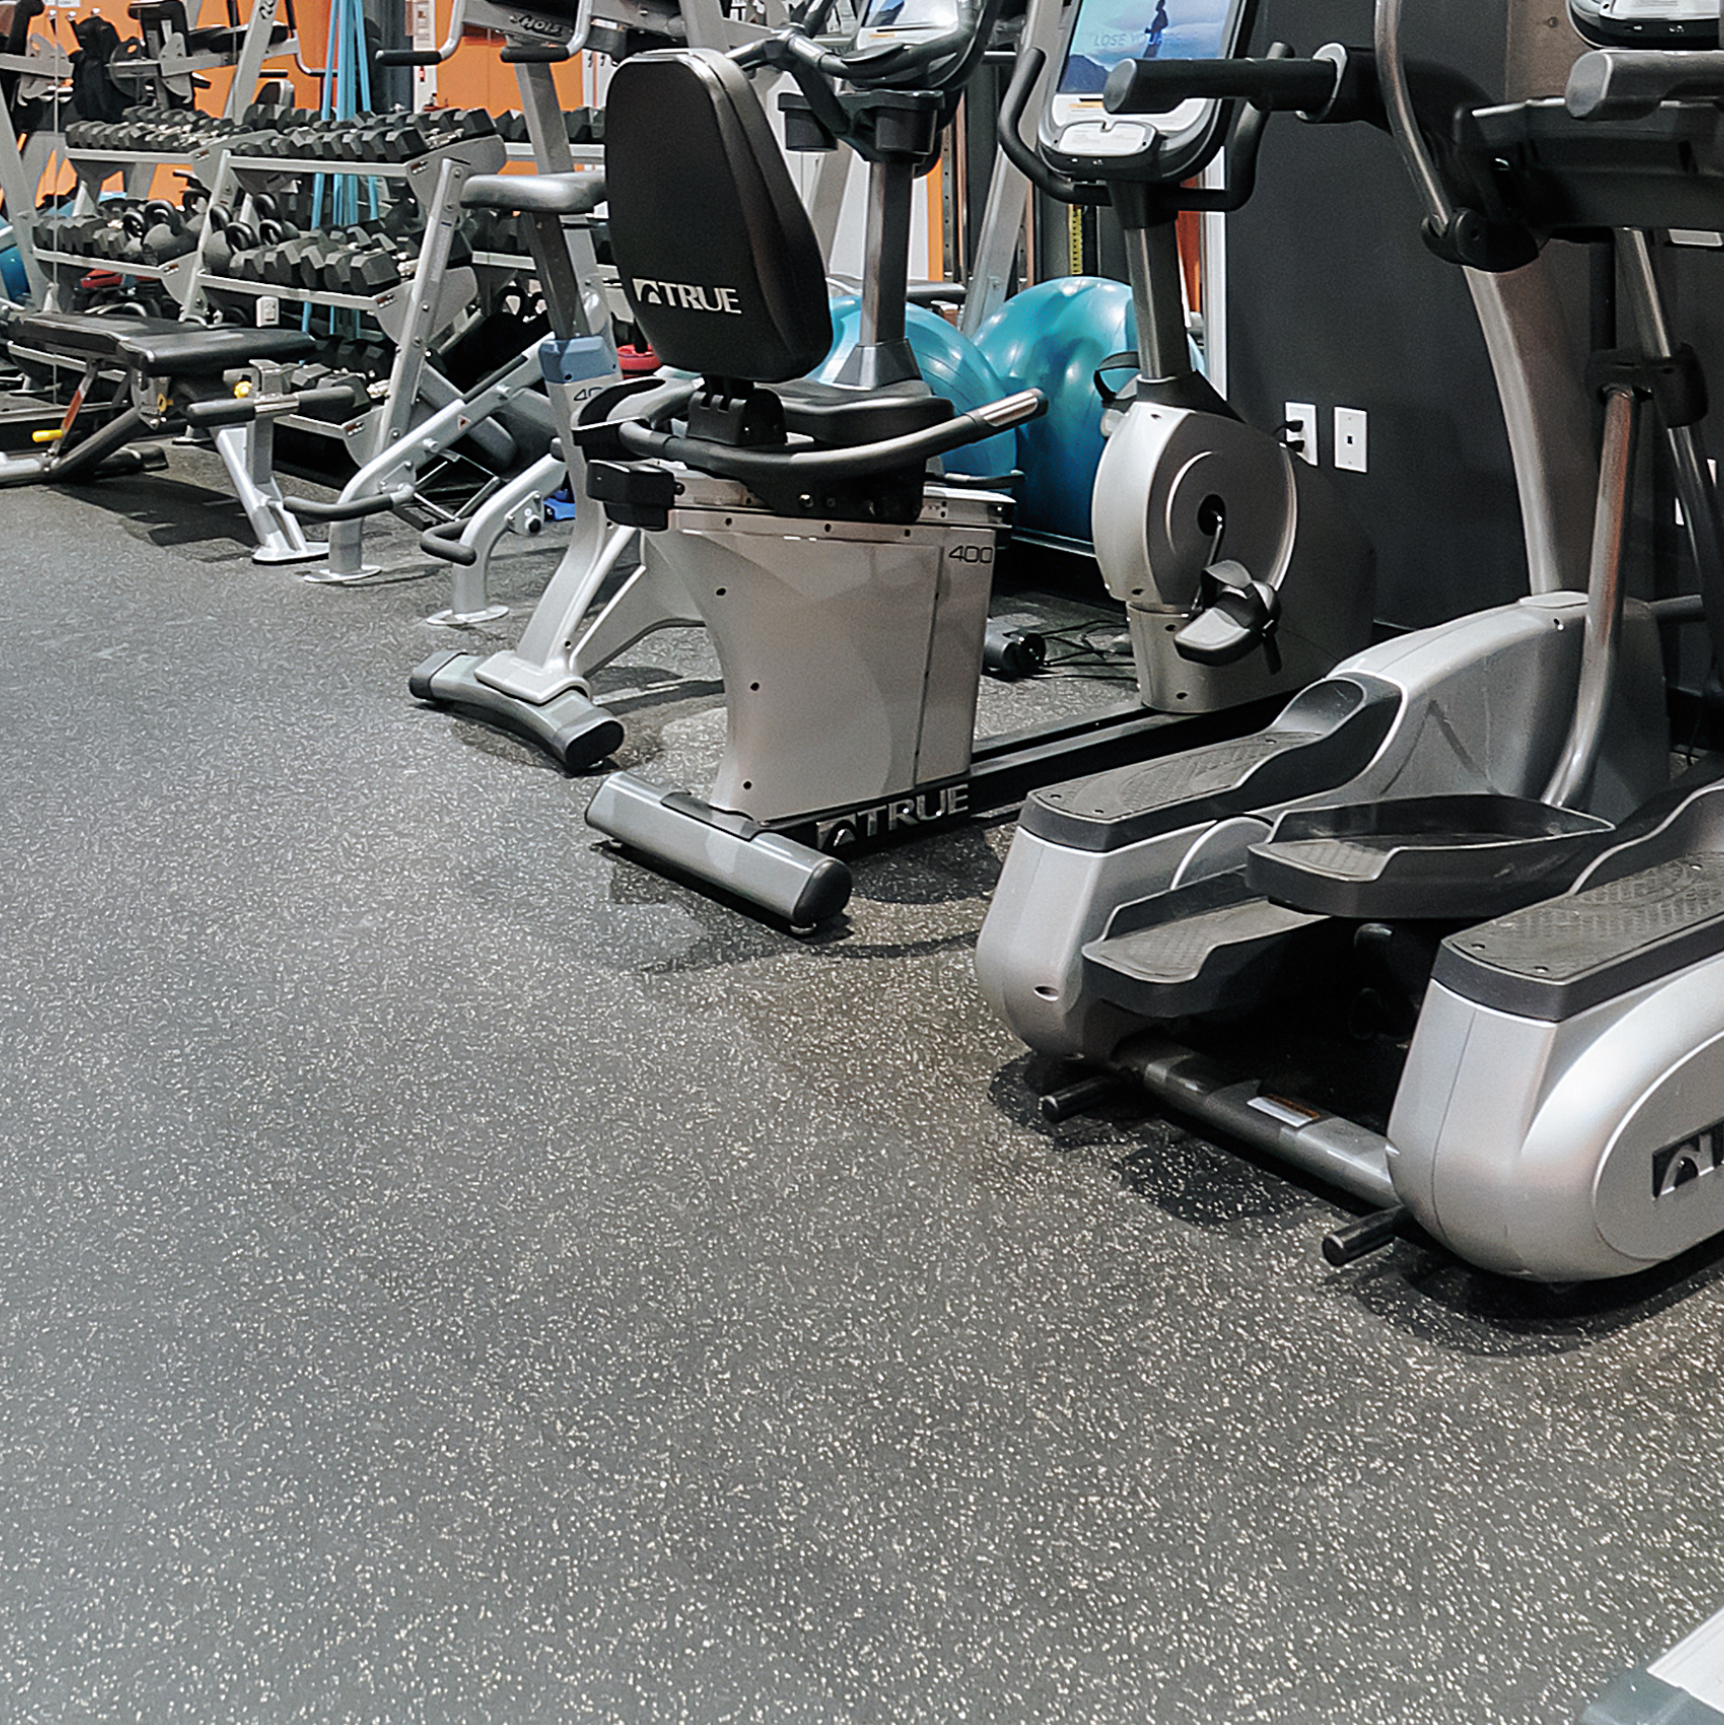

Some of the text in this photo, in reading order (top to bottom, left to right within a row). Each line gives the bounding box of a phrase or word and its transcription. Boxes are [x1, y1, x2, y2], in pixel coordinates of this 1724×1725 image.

[659, 280, 742, 314] TRUE
[949, 544, 994, 567] 400
[856, 783, 971, 847] TRUE
